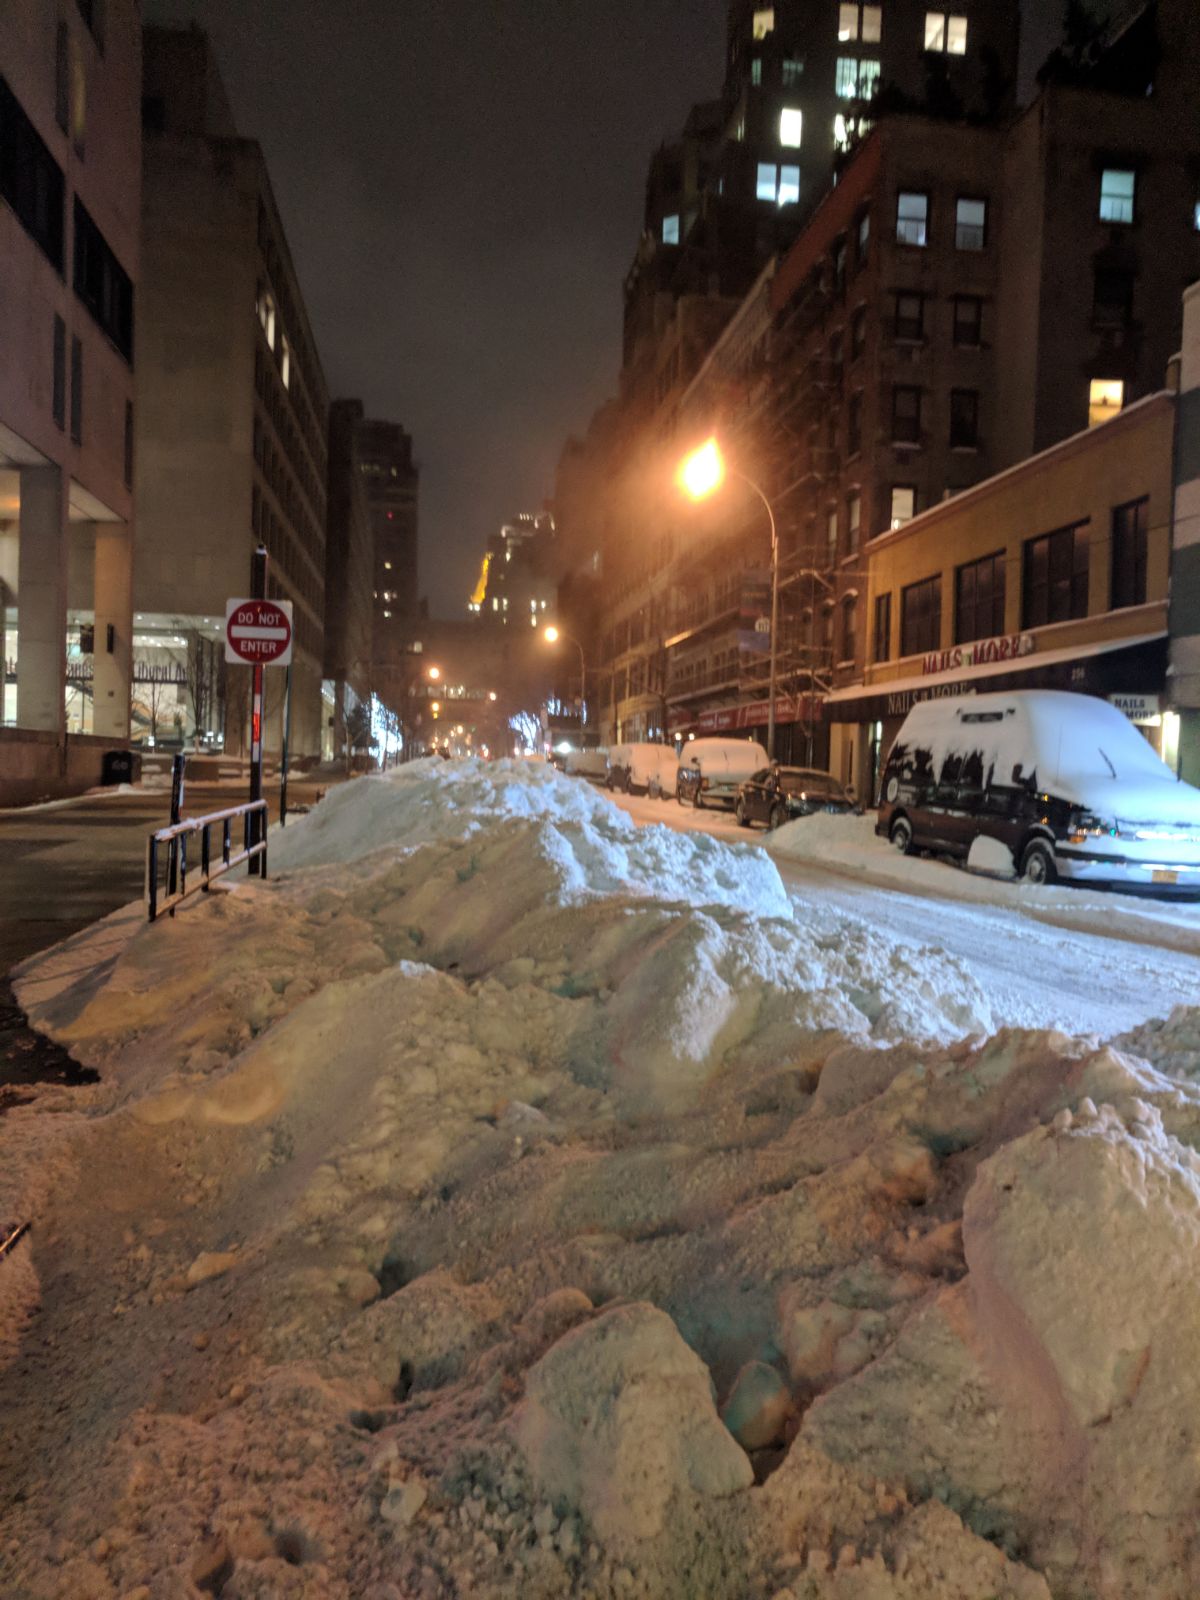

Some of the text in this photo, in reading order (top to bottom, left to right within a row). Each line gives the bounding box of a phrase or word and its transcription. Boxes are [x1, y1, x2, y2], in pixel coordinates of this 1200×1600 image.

[237, 612, 280, 626] DO NOT
[240, 640, 277, 653] ENTER
[922, 647, 962, 675] NAILS
[973, 636, 1021, 665] MORE
[887, 690, 918, 715] NAILS
[1114, 698, 1145, 708] NAILS
